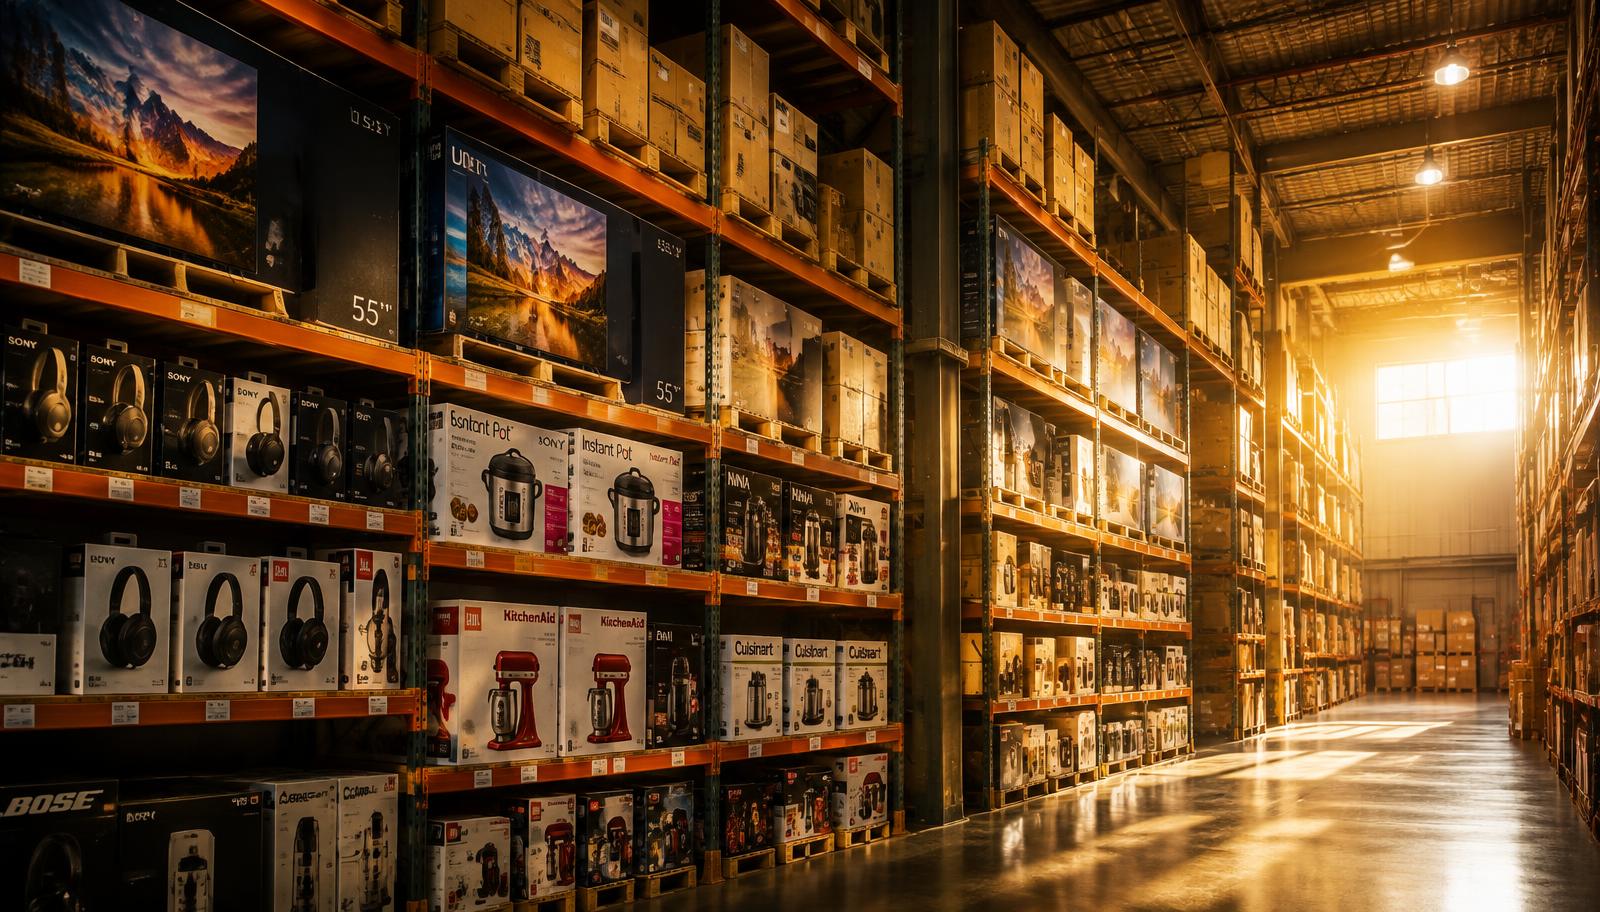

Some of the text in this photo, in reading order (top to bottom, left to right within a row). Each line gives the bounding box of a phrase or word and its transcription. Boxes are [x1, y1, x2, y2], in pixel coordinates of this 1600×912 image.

[8, 336, 38, 349] SONY
[167, 371, 192, 383] SONY
[493, 421, 511, 442] Pot
[582, 435, 614, 457] Instant
[616, 443, 633, 461] Pot
[503, 609, 556, 624] KitchenAid
[735, 640, 774, 656] Cuisinart
[3, 789, 104, 817] BOSE
